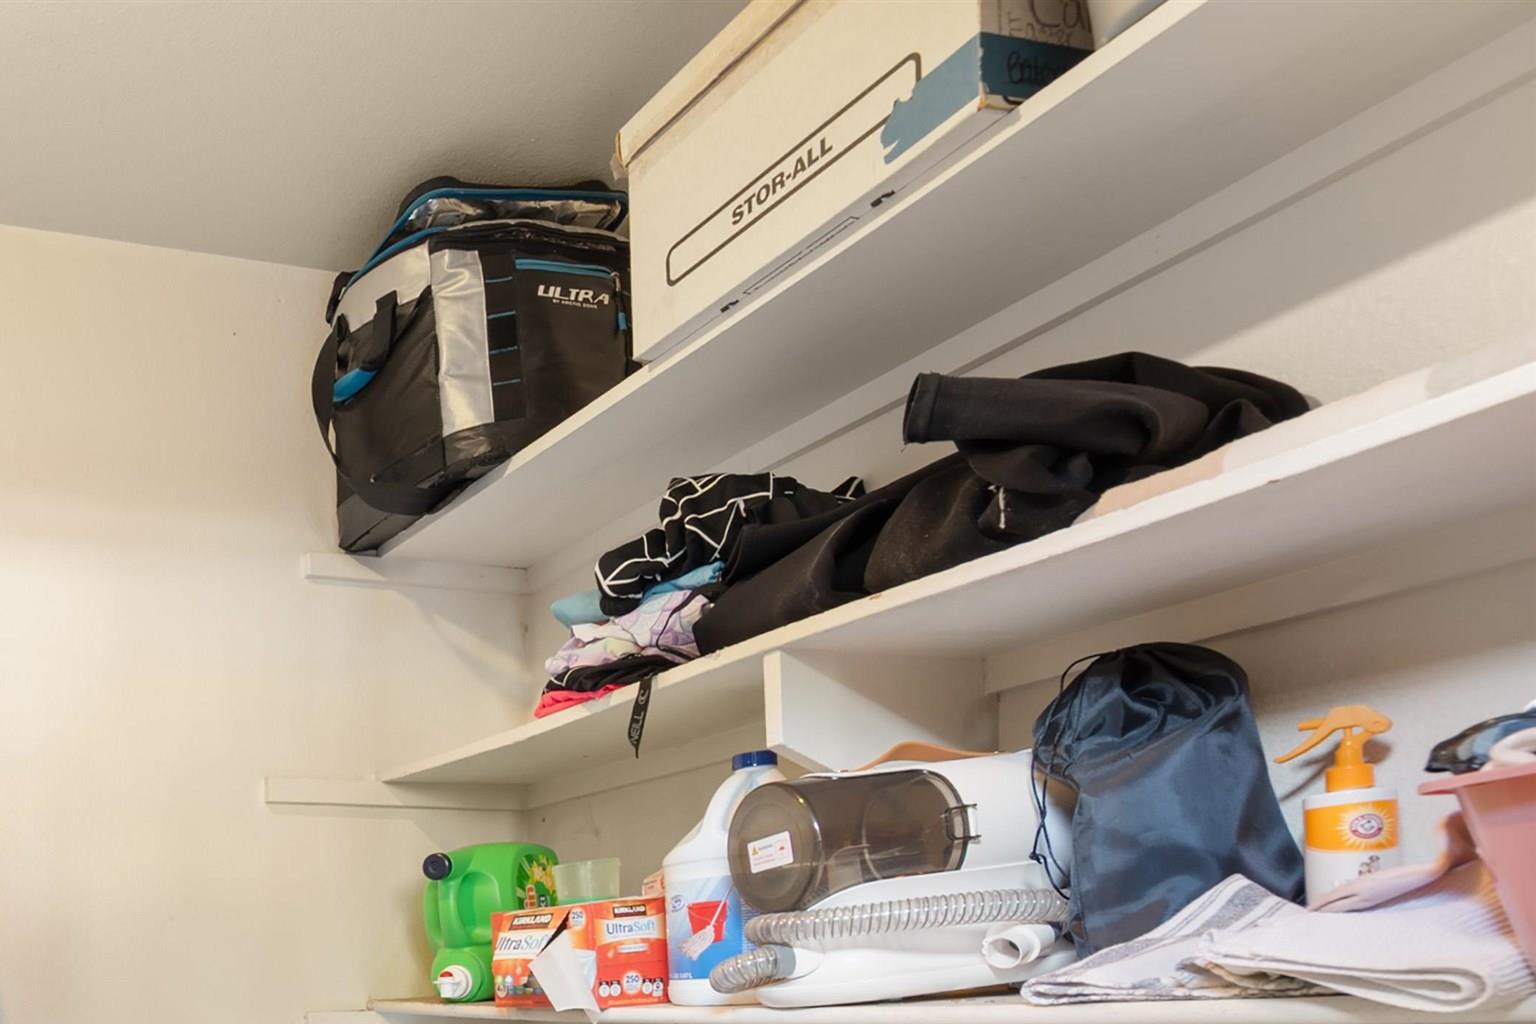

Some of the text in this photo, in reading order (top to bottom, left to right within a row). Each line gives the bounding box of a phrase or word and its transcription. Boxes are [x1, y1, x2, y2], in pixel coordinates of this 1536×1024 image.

[731, 137, 833, 226] STOR-ALL
[537, 284, 610, 305] ULTRA
[606, 919, 655, 935] UltraSoft
[625, 975, 640, 984] 250
